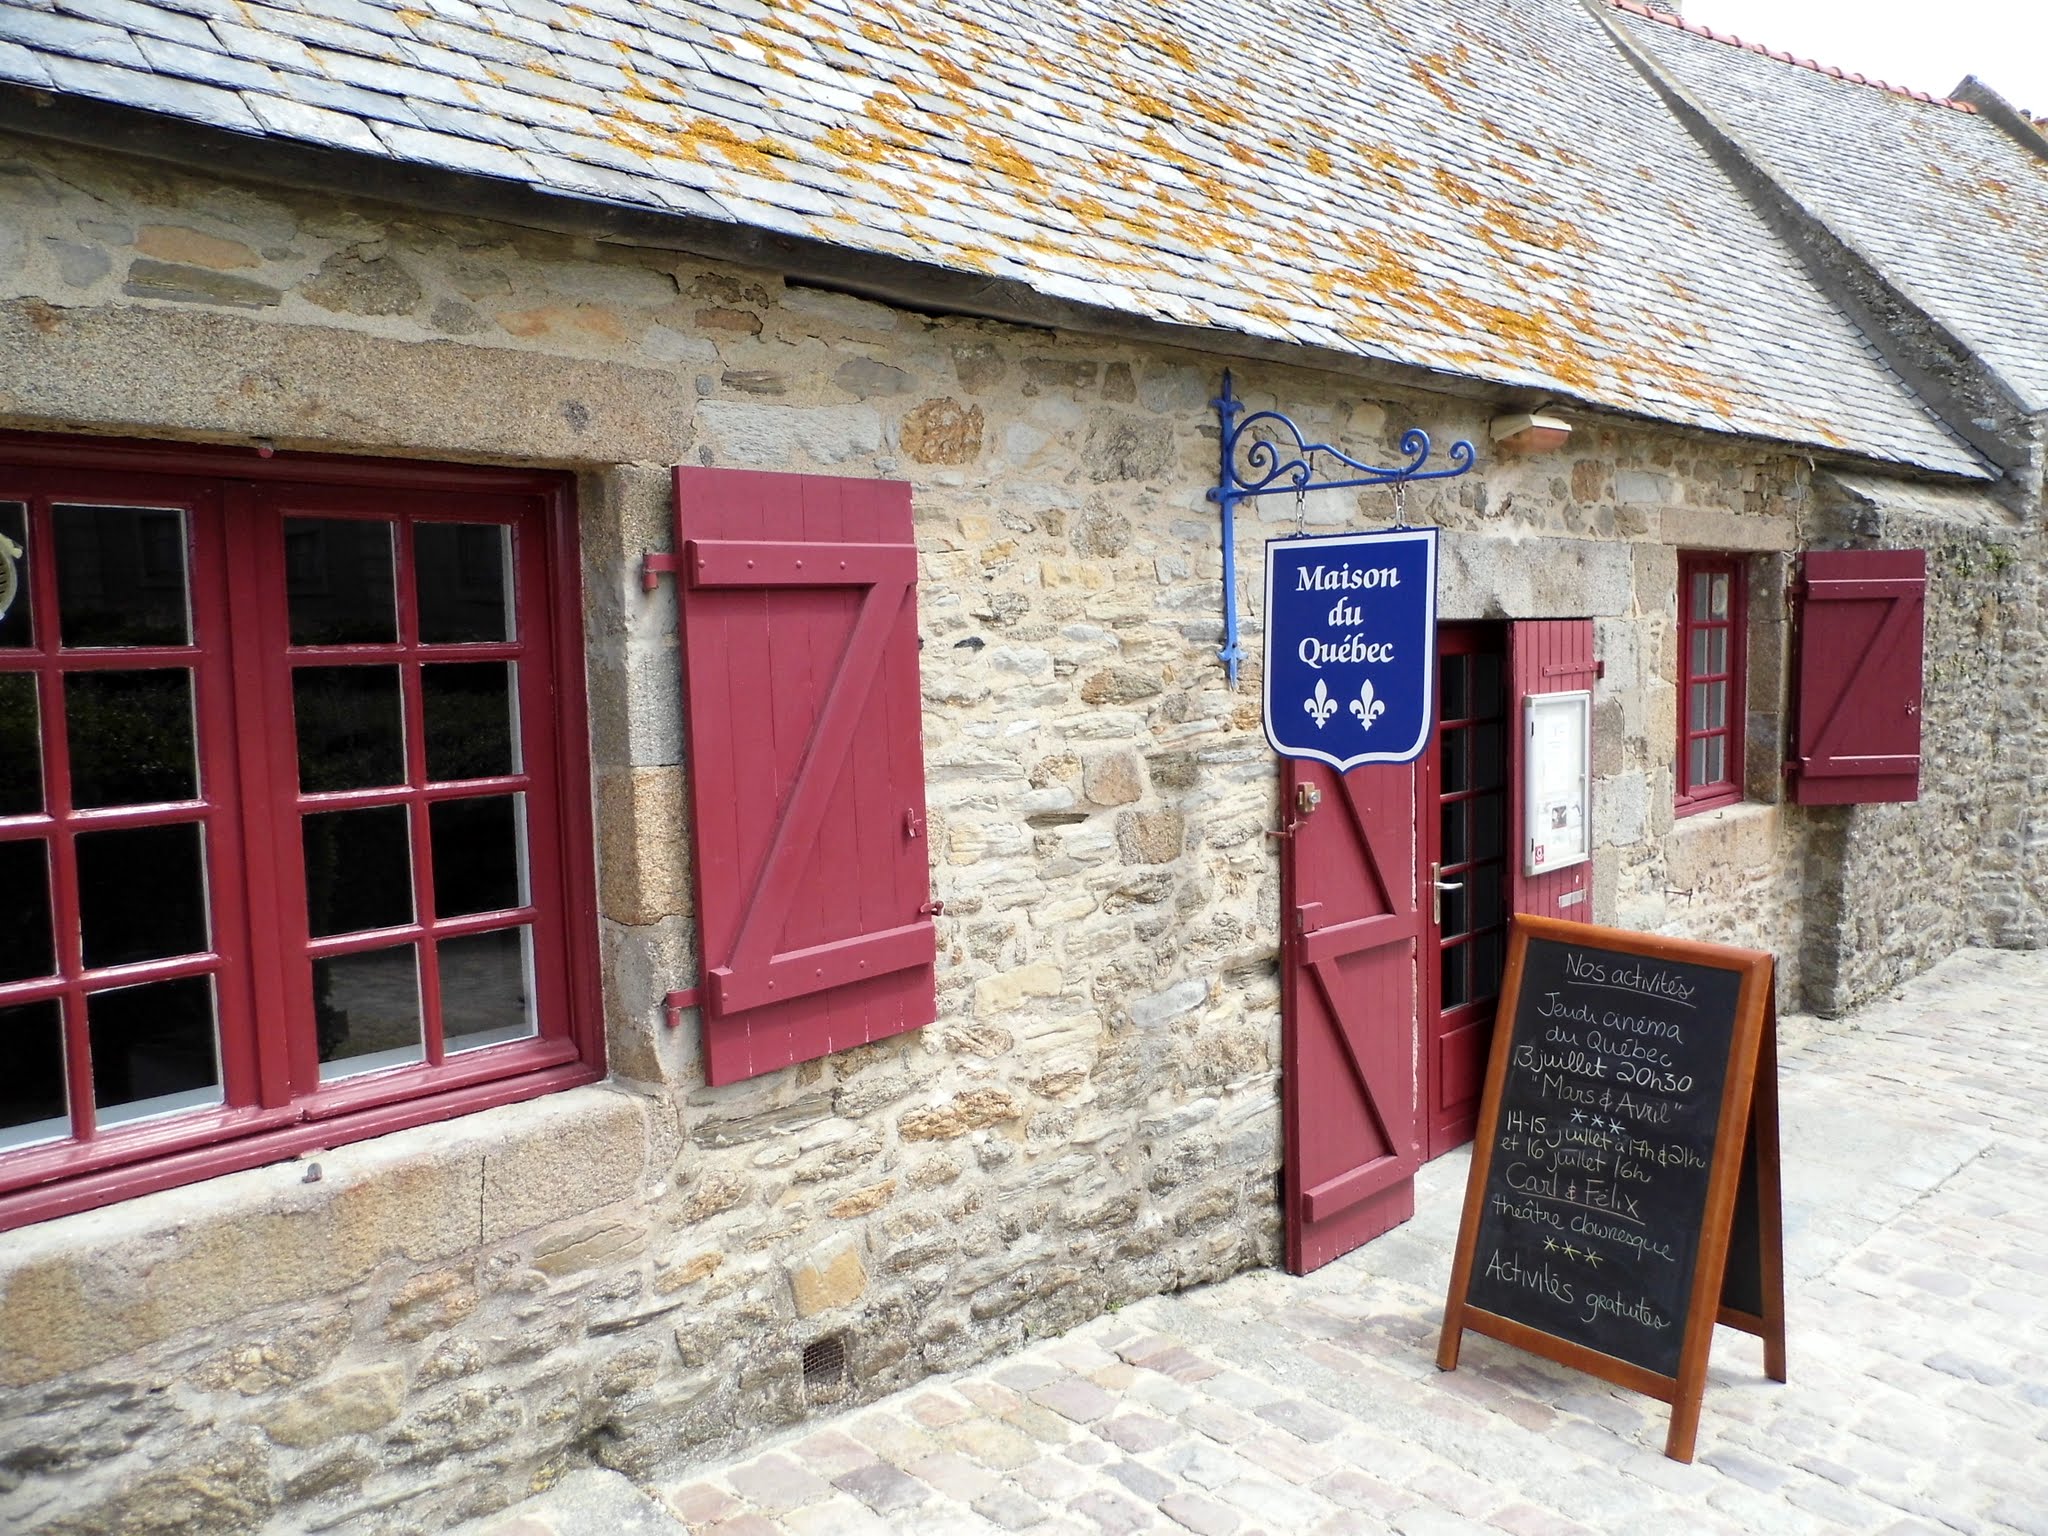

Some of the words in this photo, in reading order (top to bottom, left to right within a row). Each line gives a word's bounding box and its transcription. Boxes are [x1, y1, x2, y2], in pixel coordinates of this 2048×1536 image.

[1296, 562, 1400, 591] Maison
[1328, 596, 1363, 626] du
[1298, 633, 1394, 668] Québec
[1565, 953, 1605, 982] Nos
[1611, 964, 1695, 999] activités
[1537, 992, 1597, 1024] Jeudi
[1602, 1010, 1684, 1044] cinéma
[1546, 1026, 1579, 1046] du
[1587, 1030, 1672, 1067] Québec
[1531, 1049, 1607, 1078] juillet
[1616, 1061, 1692, 1092] 20h30
[1507, 1110, 1547, 1134] 14-15
[1546, 1128, 1613, 1148] juillet
[1629, 1140, 1654, 1160] 17h
[1500, 1134, 1519, 1150] et
[1527, 1138, 1544, 1159] 16
[1547, 1150, 1606, 1172] juillet
[1614, 1156, 1651, 1183] 16h
[1506, 1162, 1557, 1198] Carl
[1570, 1213, 1675, 1261] clownesque
[1485, 1249, 1574, 1304] Activités
[1581, 1291, 1671, 1330] gratuites
